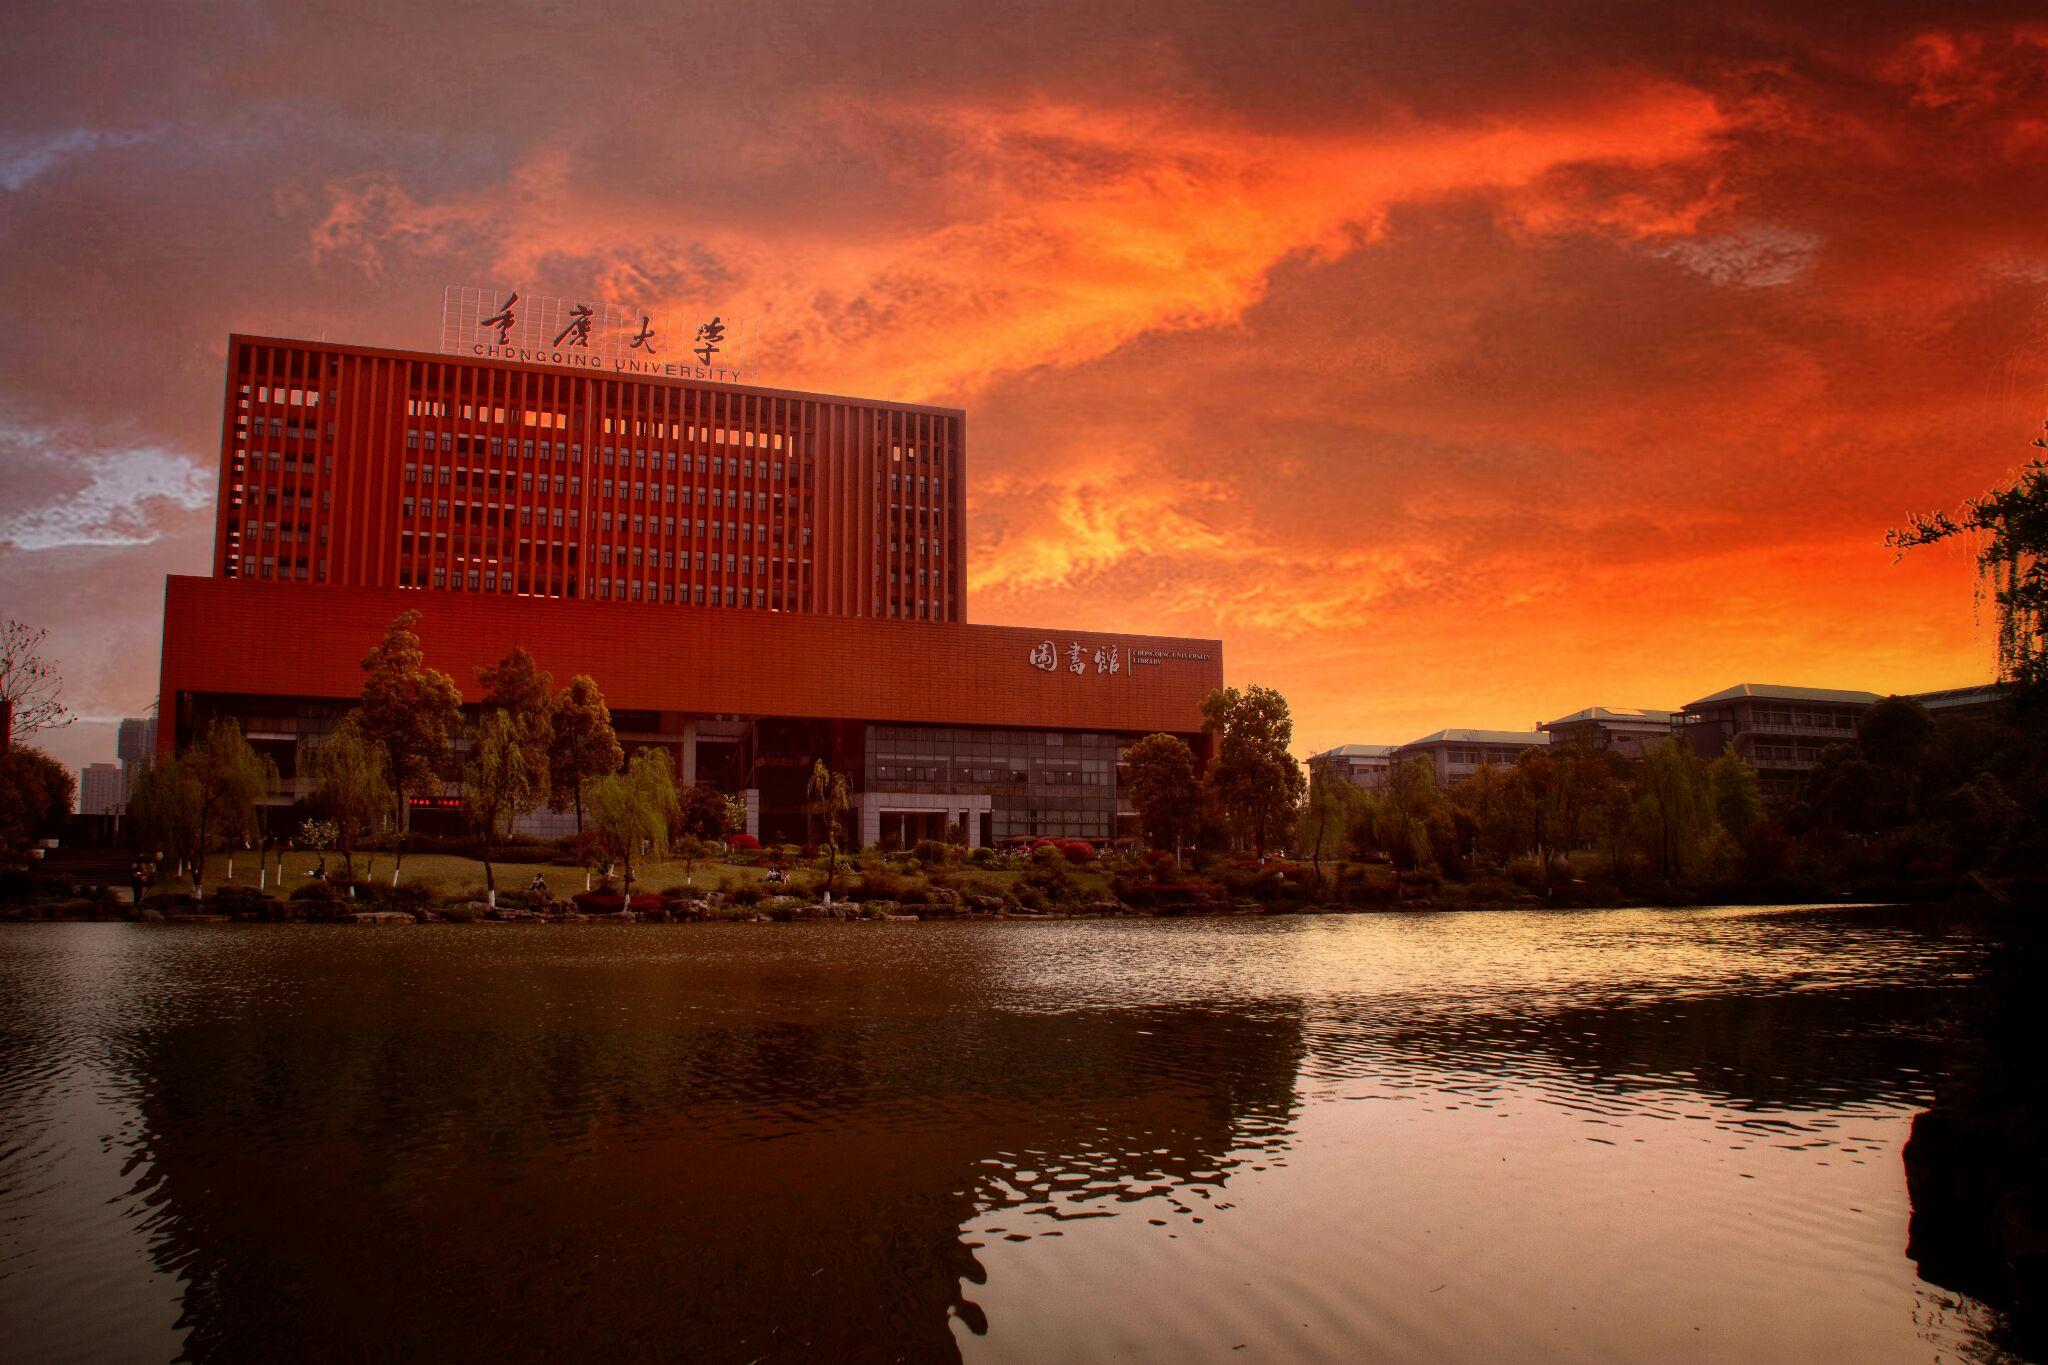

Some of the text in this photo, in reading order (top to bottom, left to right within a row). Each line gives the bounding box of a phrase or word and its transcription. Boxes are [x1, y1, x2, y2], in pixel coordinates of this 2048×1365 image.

[473, 344, 743, 382] CHONGQING UNIVERSITY
[1132, 650, 1211, 660] CHONGQING UNIVERSITY
[1133, 657, 1161, 665] LIBRARY
